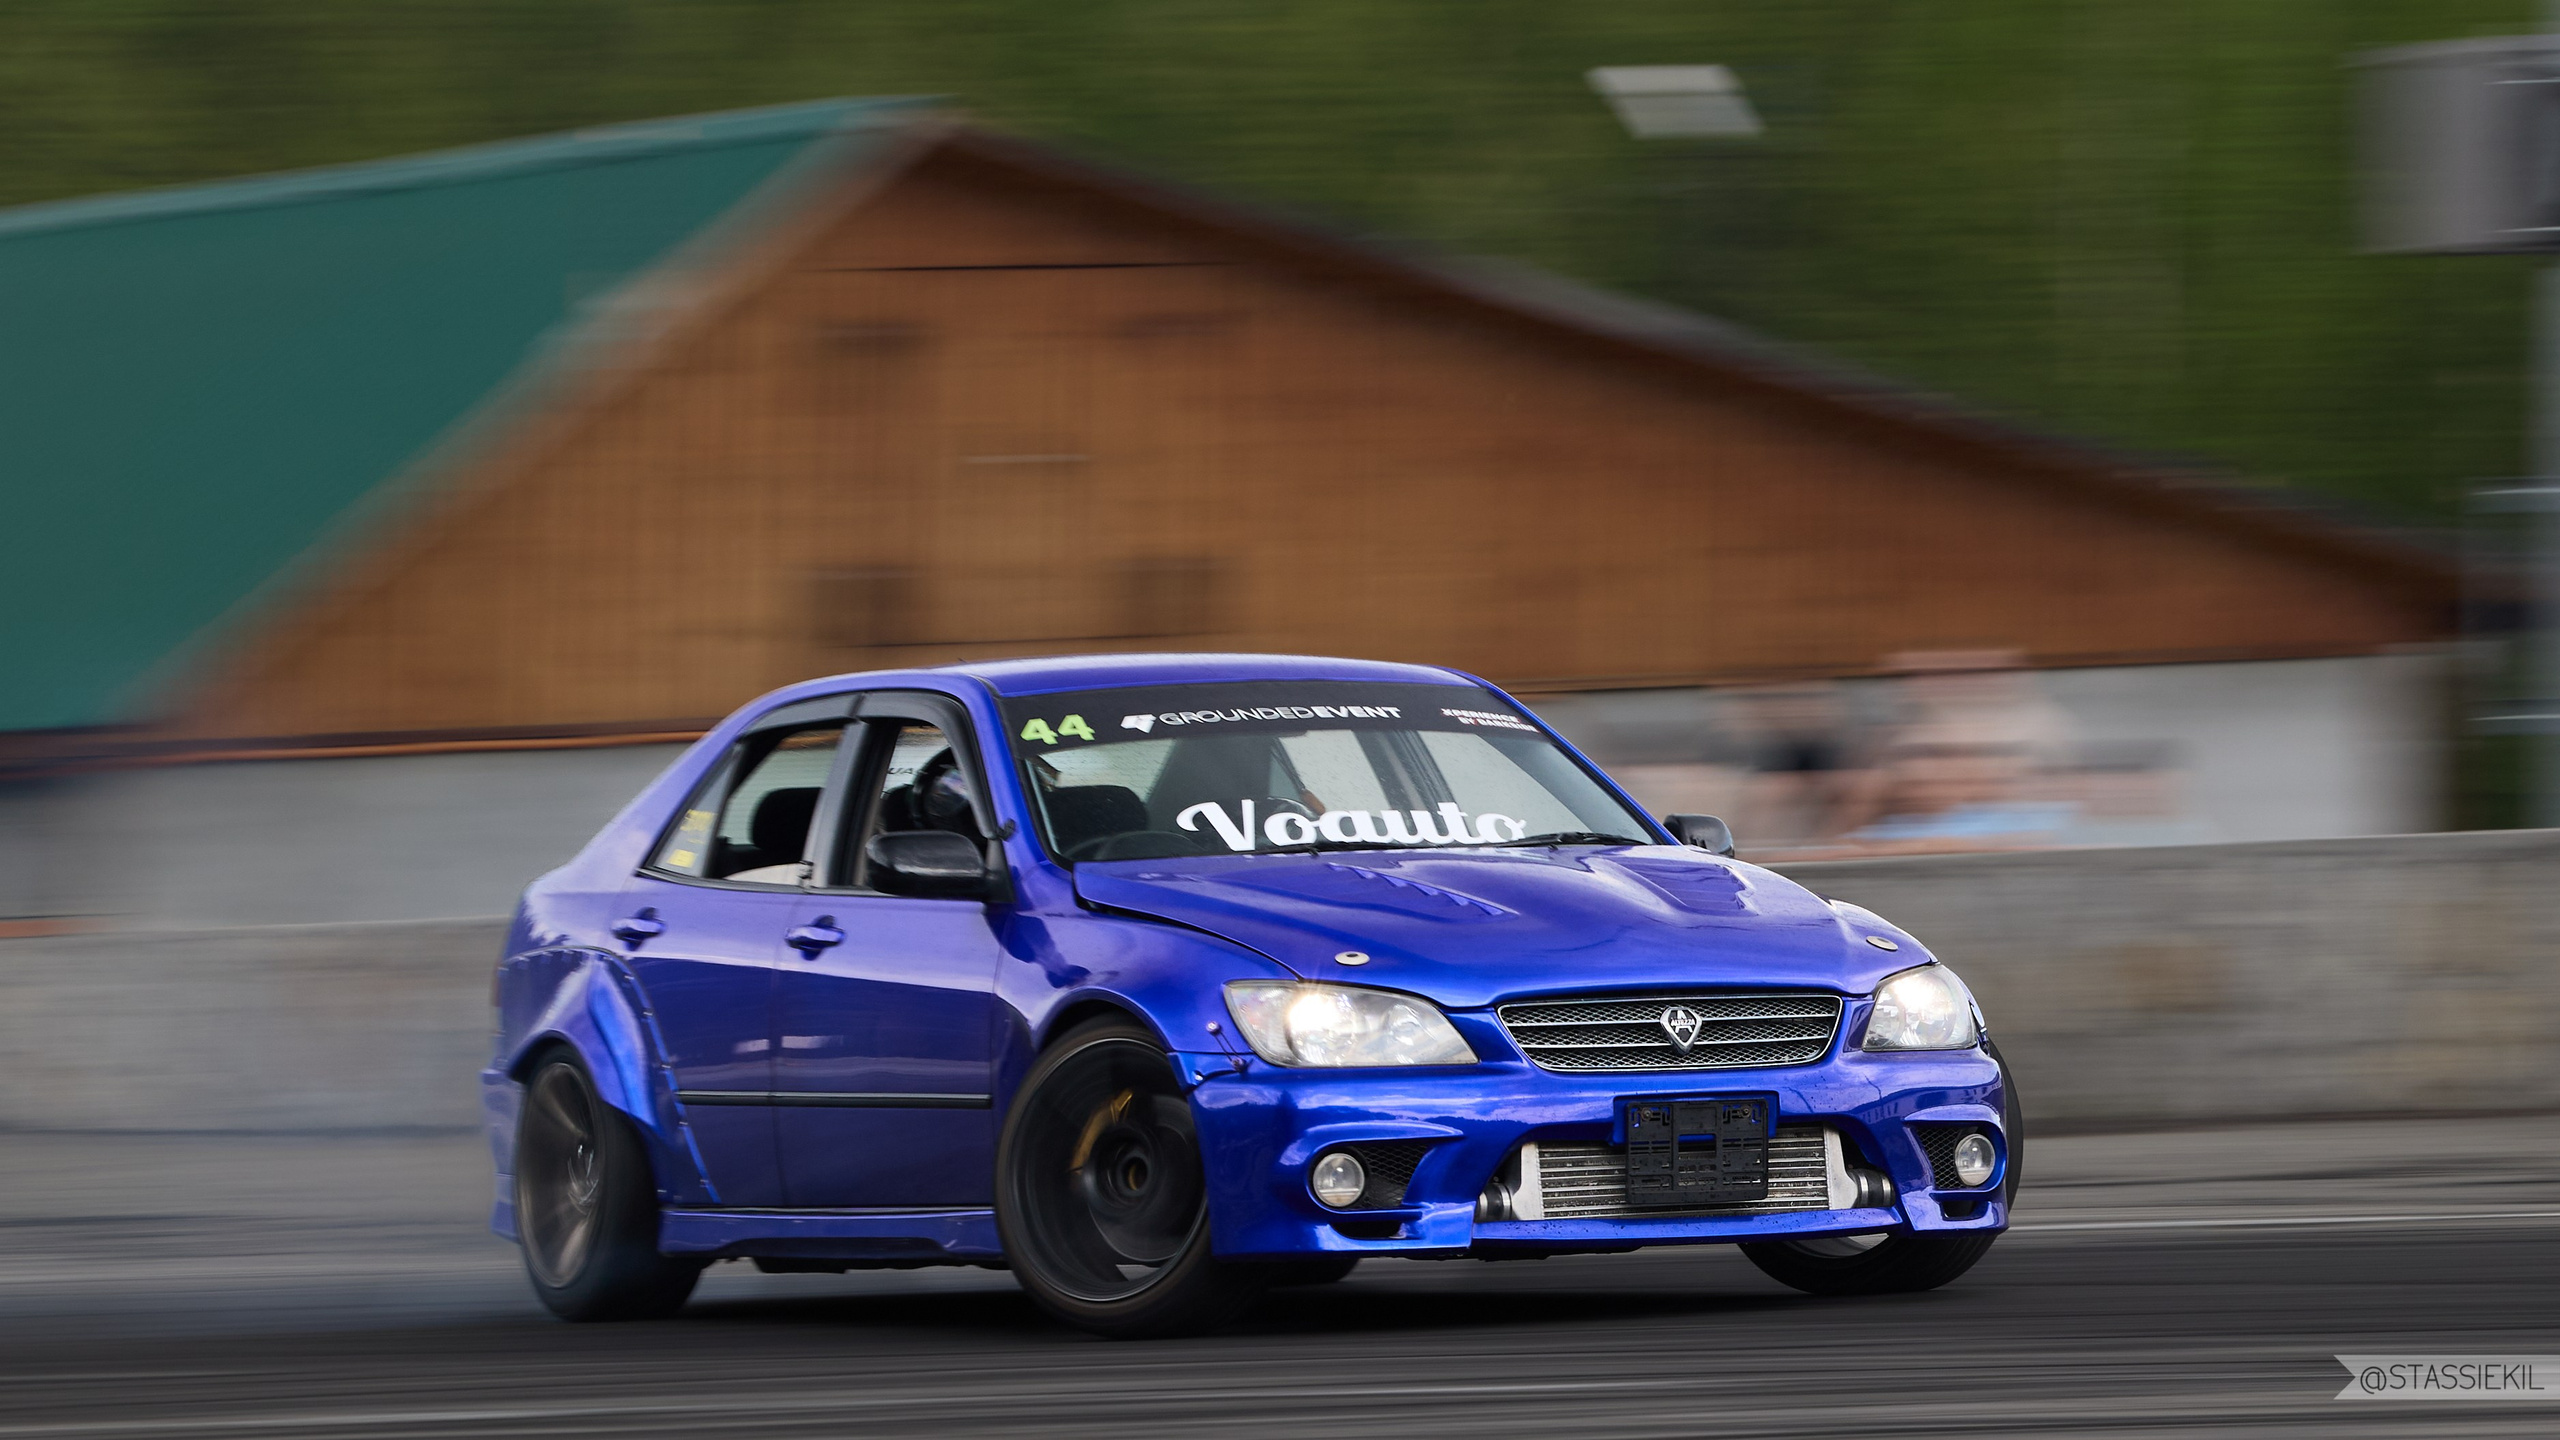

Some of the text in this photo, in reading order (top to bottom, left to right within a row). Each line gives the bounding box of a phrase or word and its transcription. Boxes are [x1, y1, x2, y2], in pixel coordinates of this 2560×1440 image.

[1020, 714, 1095, 745] 44
[1440, 708, 1520, 723] XPERIENCE
[1175, 799, 1527, 851] Voauto
